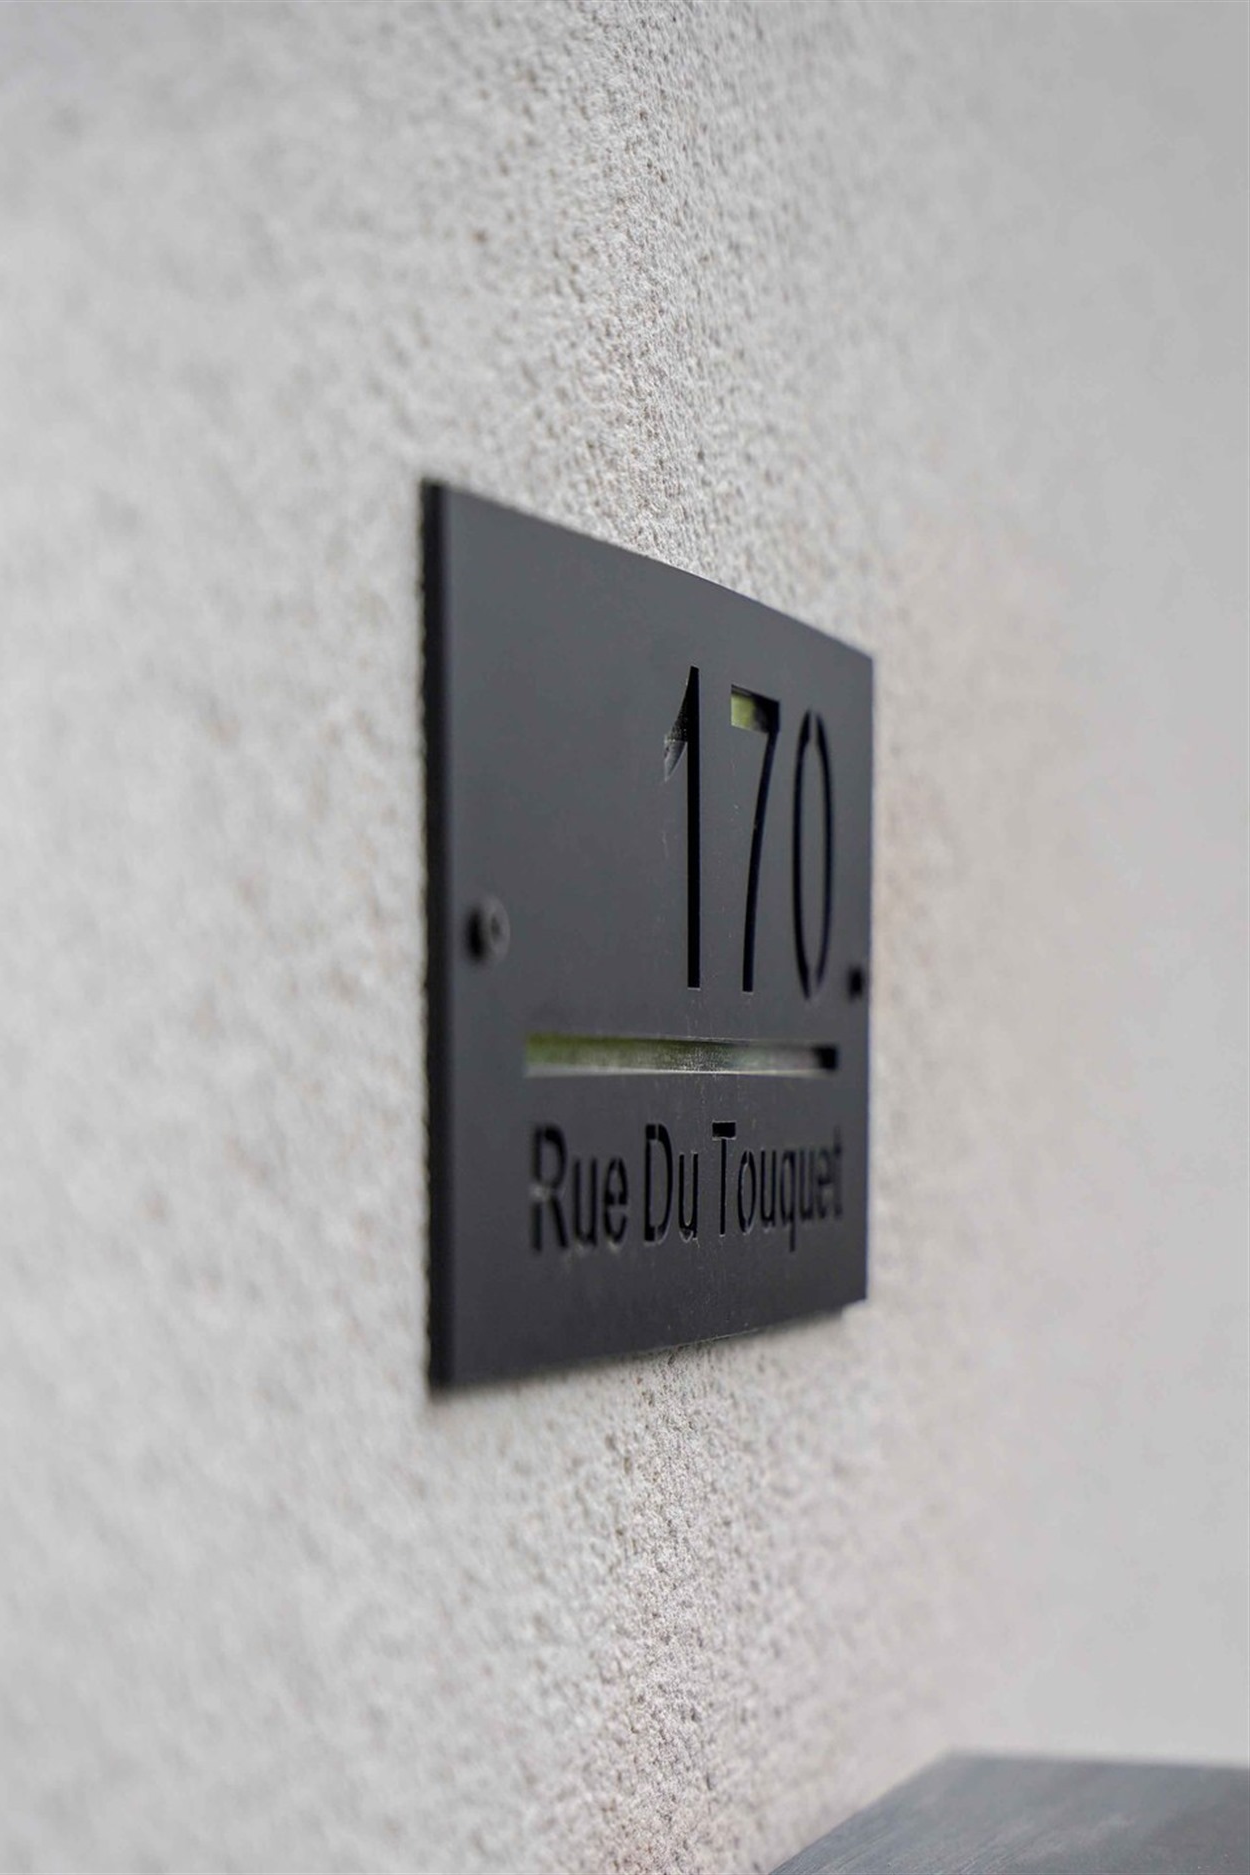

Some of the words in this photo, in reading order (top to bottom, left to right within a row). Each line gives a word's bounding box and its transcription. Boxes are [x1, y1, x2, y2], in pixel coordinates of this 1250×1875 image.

[664, 665, 833, 998] 170
[530, 1123, 628, 1251] Rue
[644, 1123, 699, 1243] Du
[712, 1120, 843, 1251] Touquet
